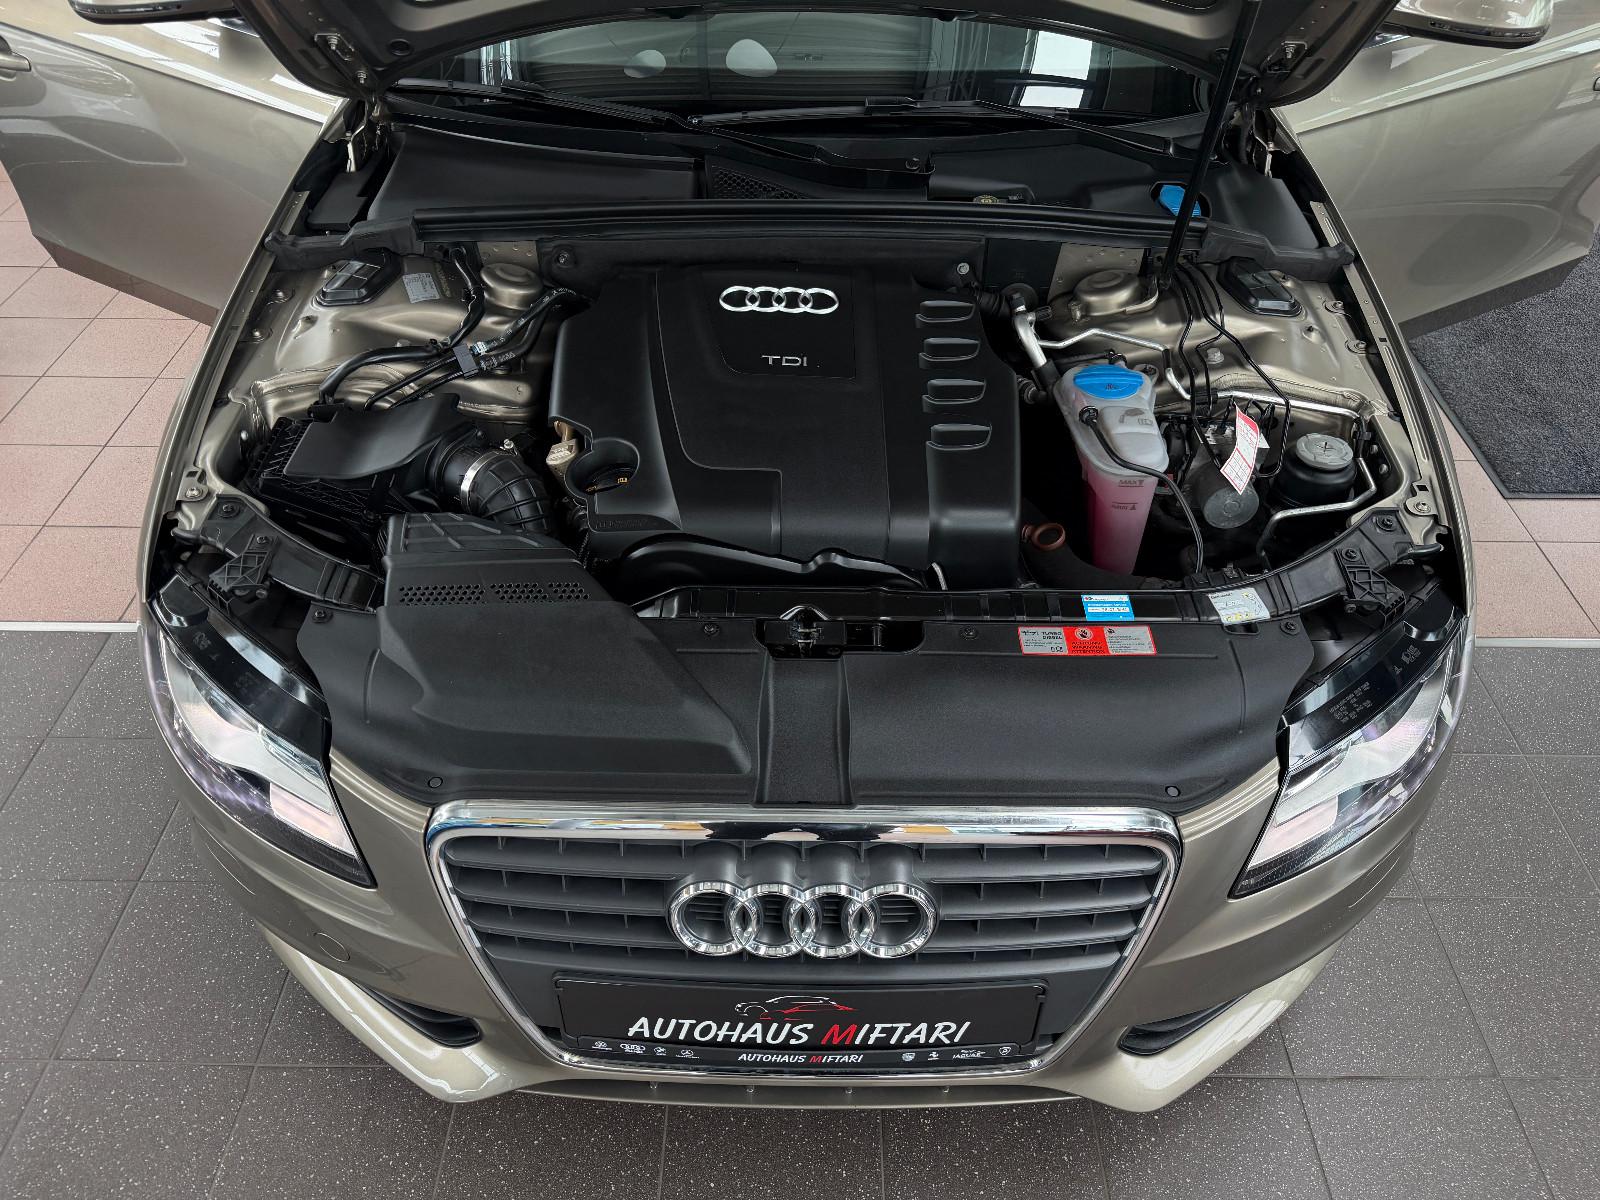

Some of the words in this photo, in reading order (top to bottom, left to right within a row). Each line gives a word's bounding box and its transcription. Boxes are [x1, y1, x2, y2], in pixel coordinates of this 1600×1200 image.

[761, 355, 808, 367] TDI
[627, 1016, 814, 1045] AUTOHAUS
[820, 1021, 971, 1045] MIFTARI
[737, 1053, 806, 1063] AUTOHAUS
[808, 1054, 864, 1063] MIFTARI
